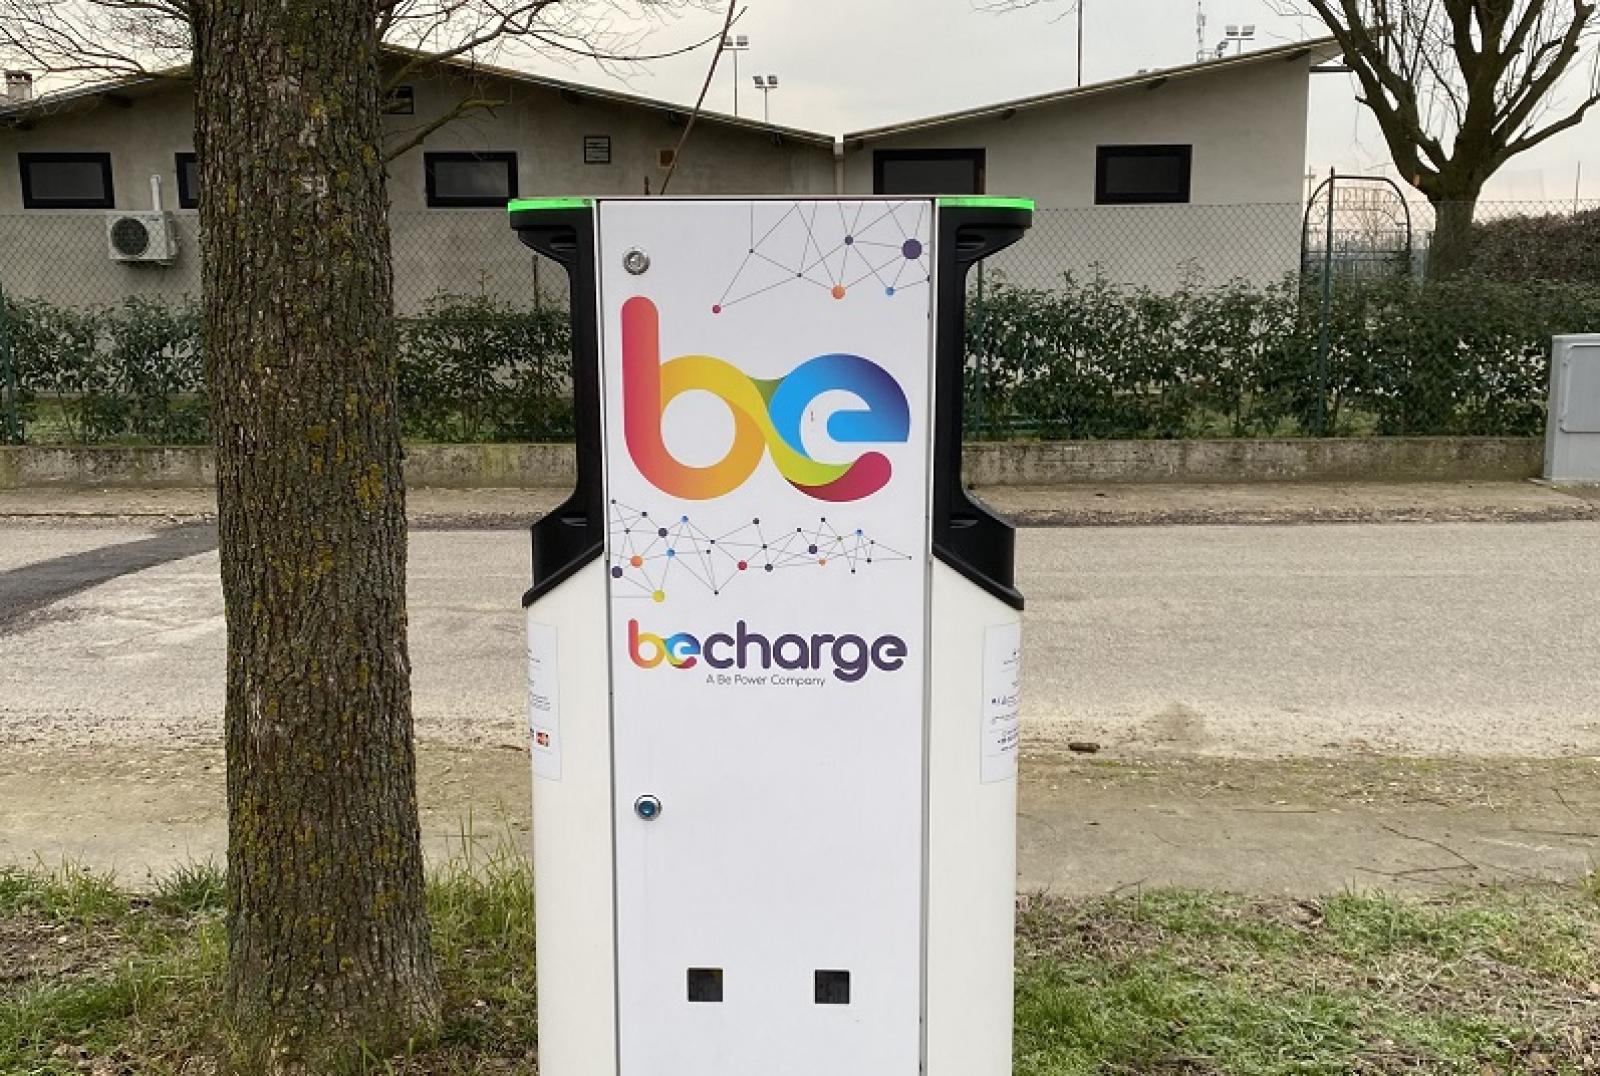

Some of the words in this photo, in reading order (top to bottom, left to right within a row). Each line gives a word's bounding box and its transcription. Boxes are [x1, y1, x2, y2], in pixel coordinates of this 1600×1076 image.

[620, 296, 911, 502] be
[628, 618, 907, 682] becharge
[706, 674, 714, 684] A
[717, 674, 731, 684] Be
[734, 674, 766, 684] Power
[770, 674, 826, 687] Company
